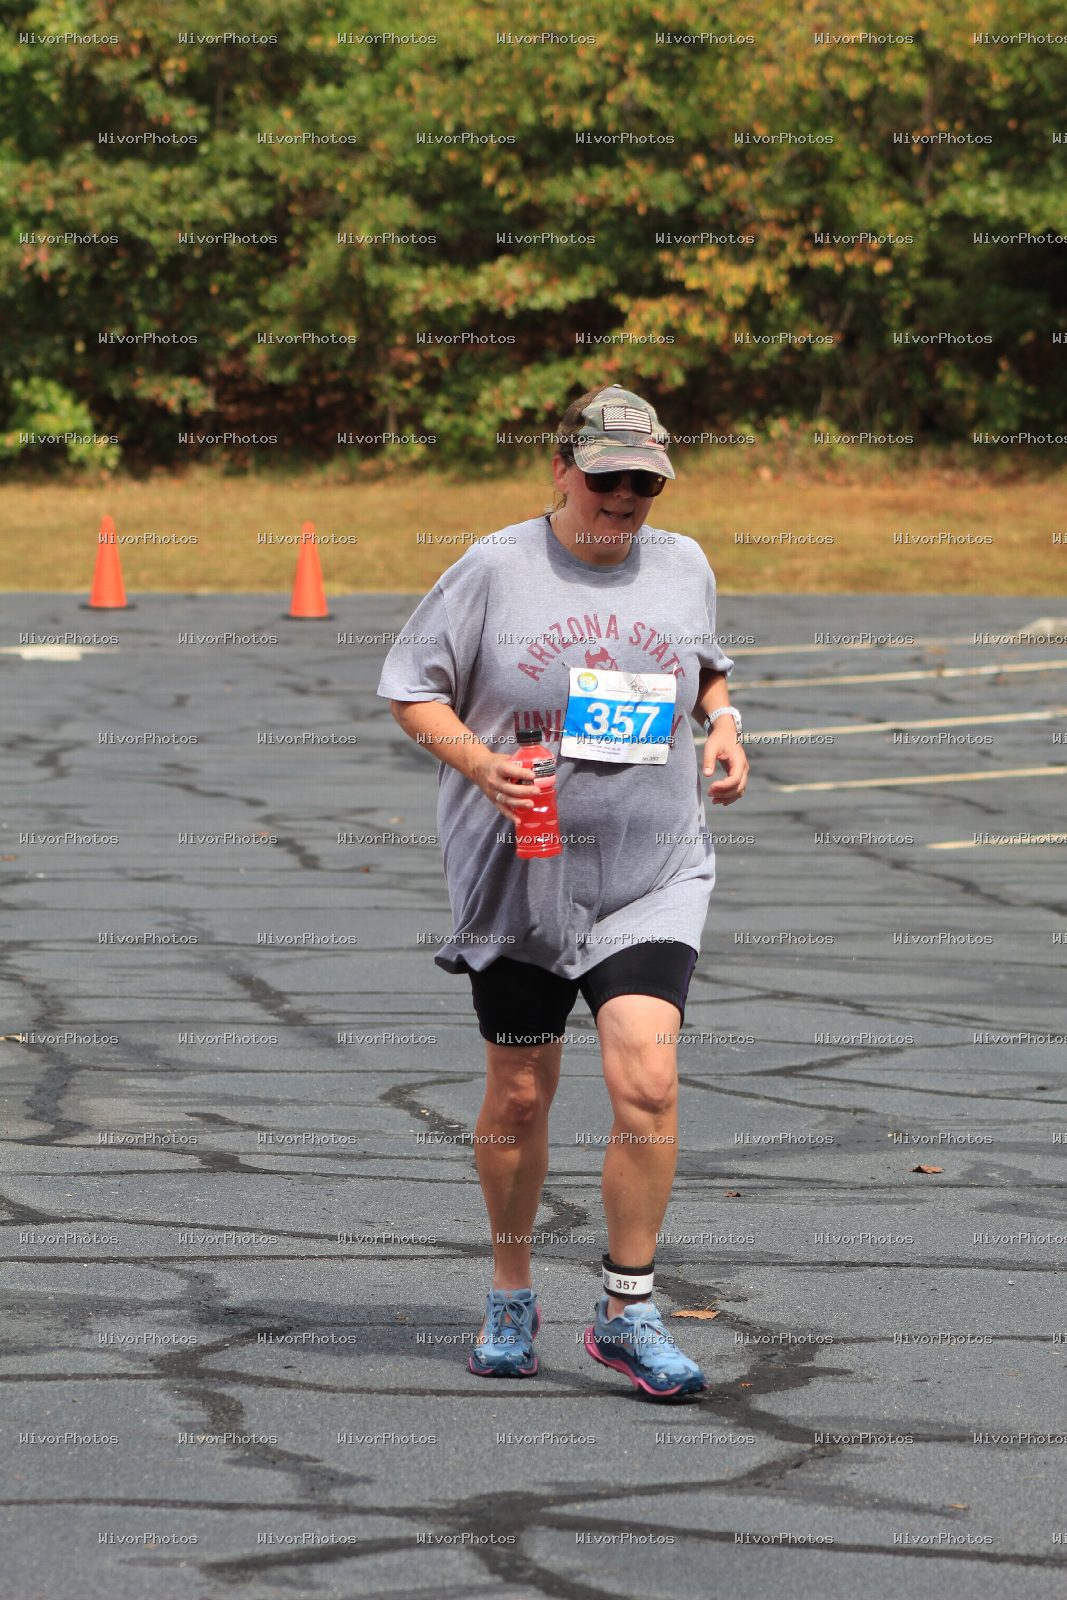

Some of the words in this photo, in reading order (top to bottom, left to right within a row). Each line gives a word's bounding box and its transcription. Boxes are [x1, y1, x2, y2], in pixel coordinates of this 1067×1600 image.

[517, 613, 620, 682] ARIZONA
[584, 702, 660, 740] 357
[615, 1279, 638, 1290] 357
